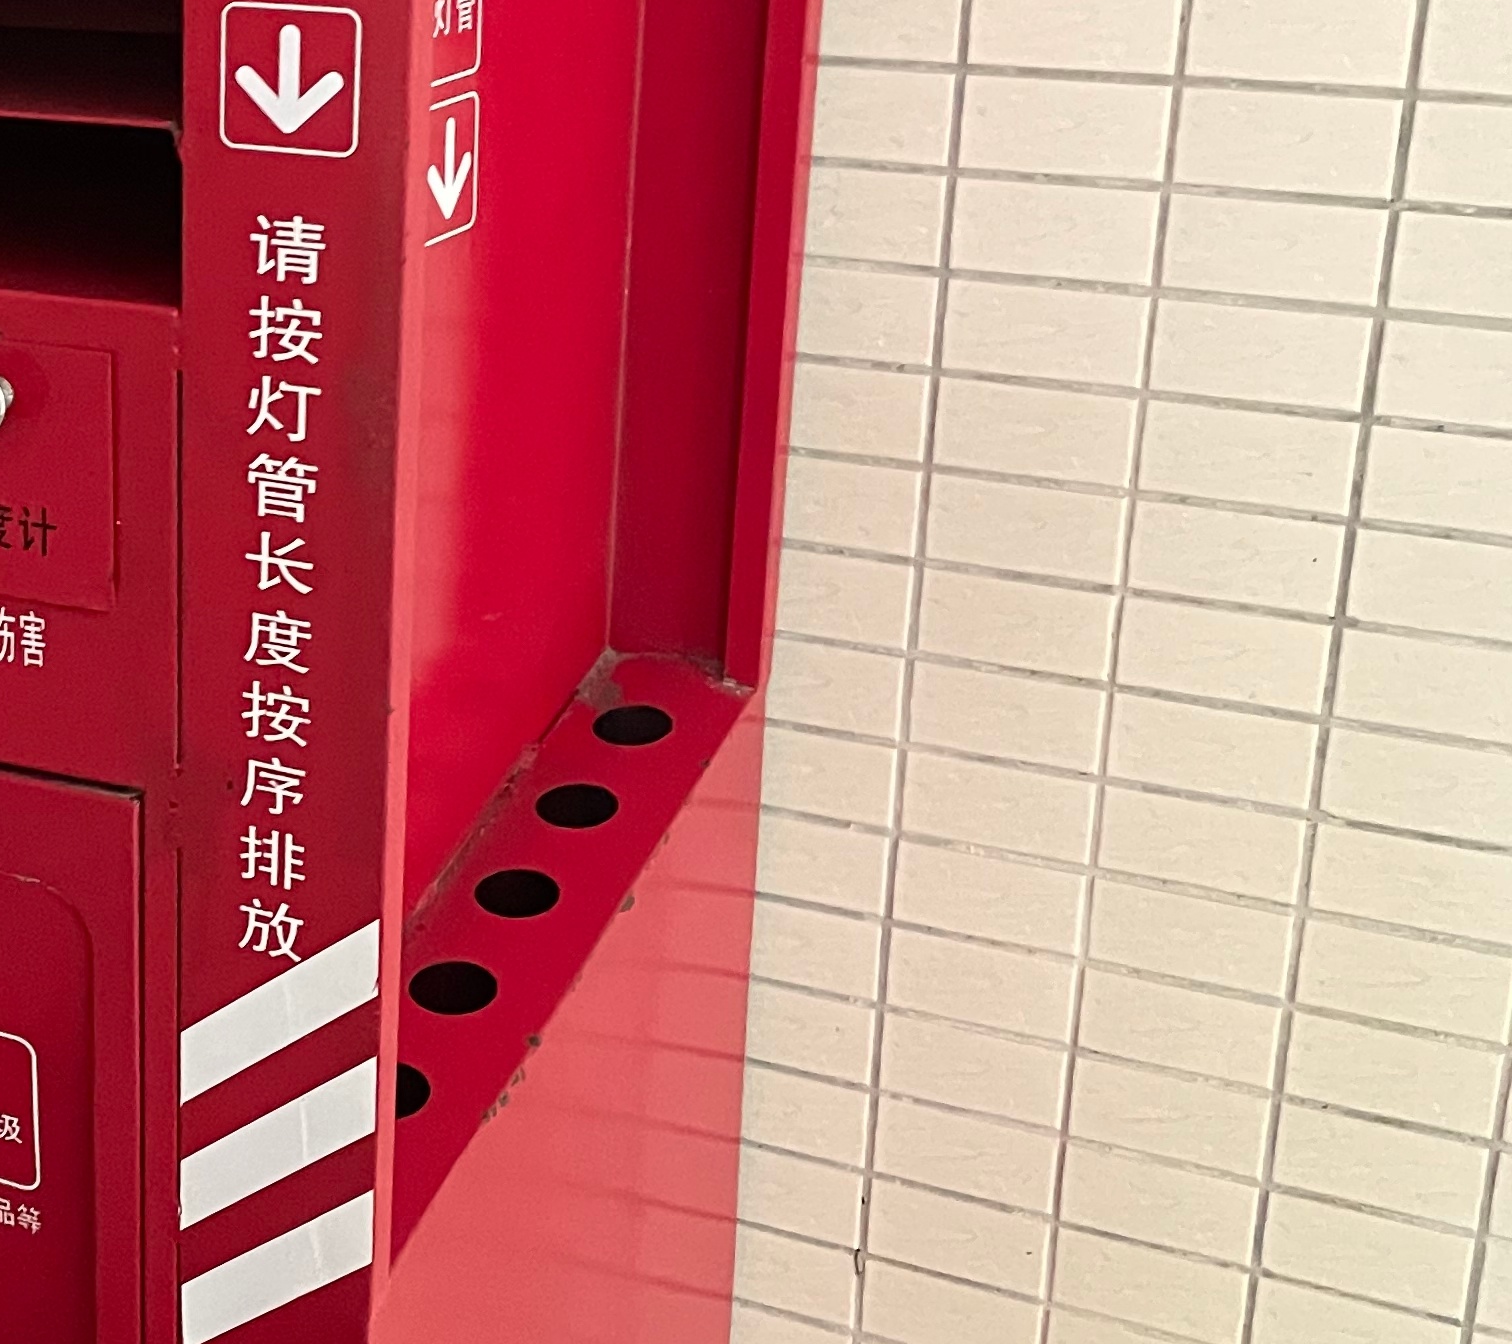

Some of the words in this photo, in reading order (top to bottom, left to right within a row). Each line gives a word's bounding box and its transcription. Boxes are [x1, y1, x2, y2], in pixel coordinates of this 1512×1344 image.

[238, 214, 327, 963] 请按灯管长度按序排放
